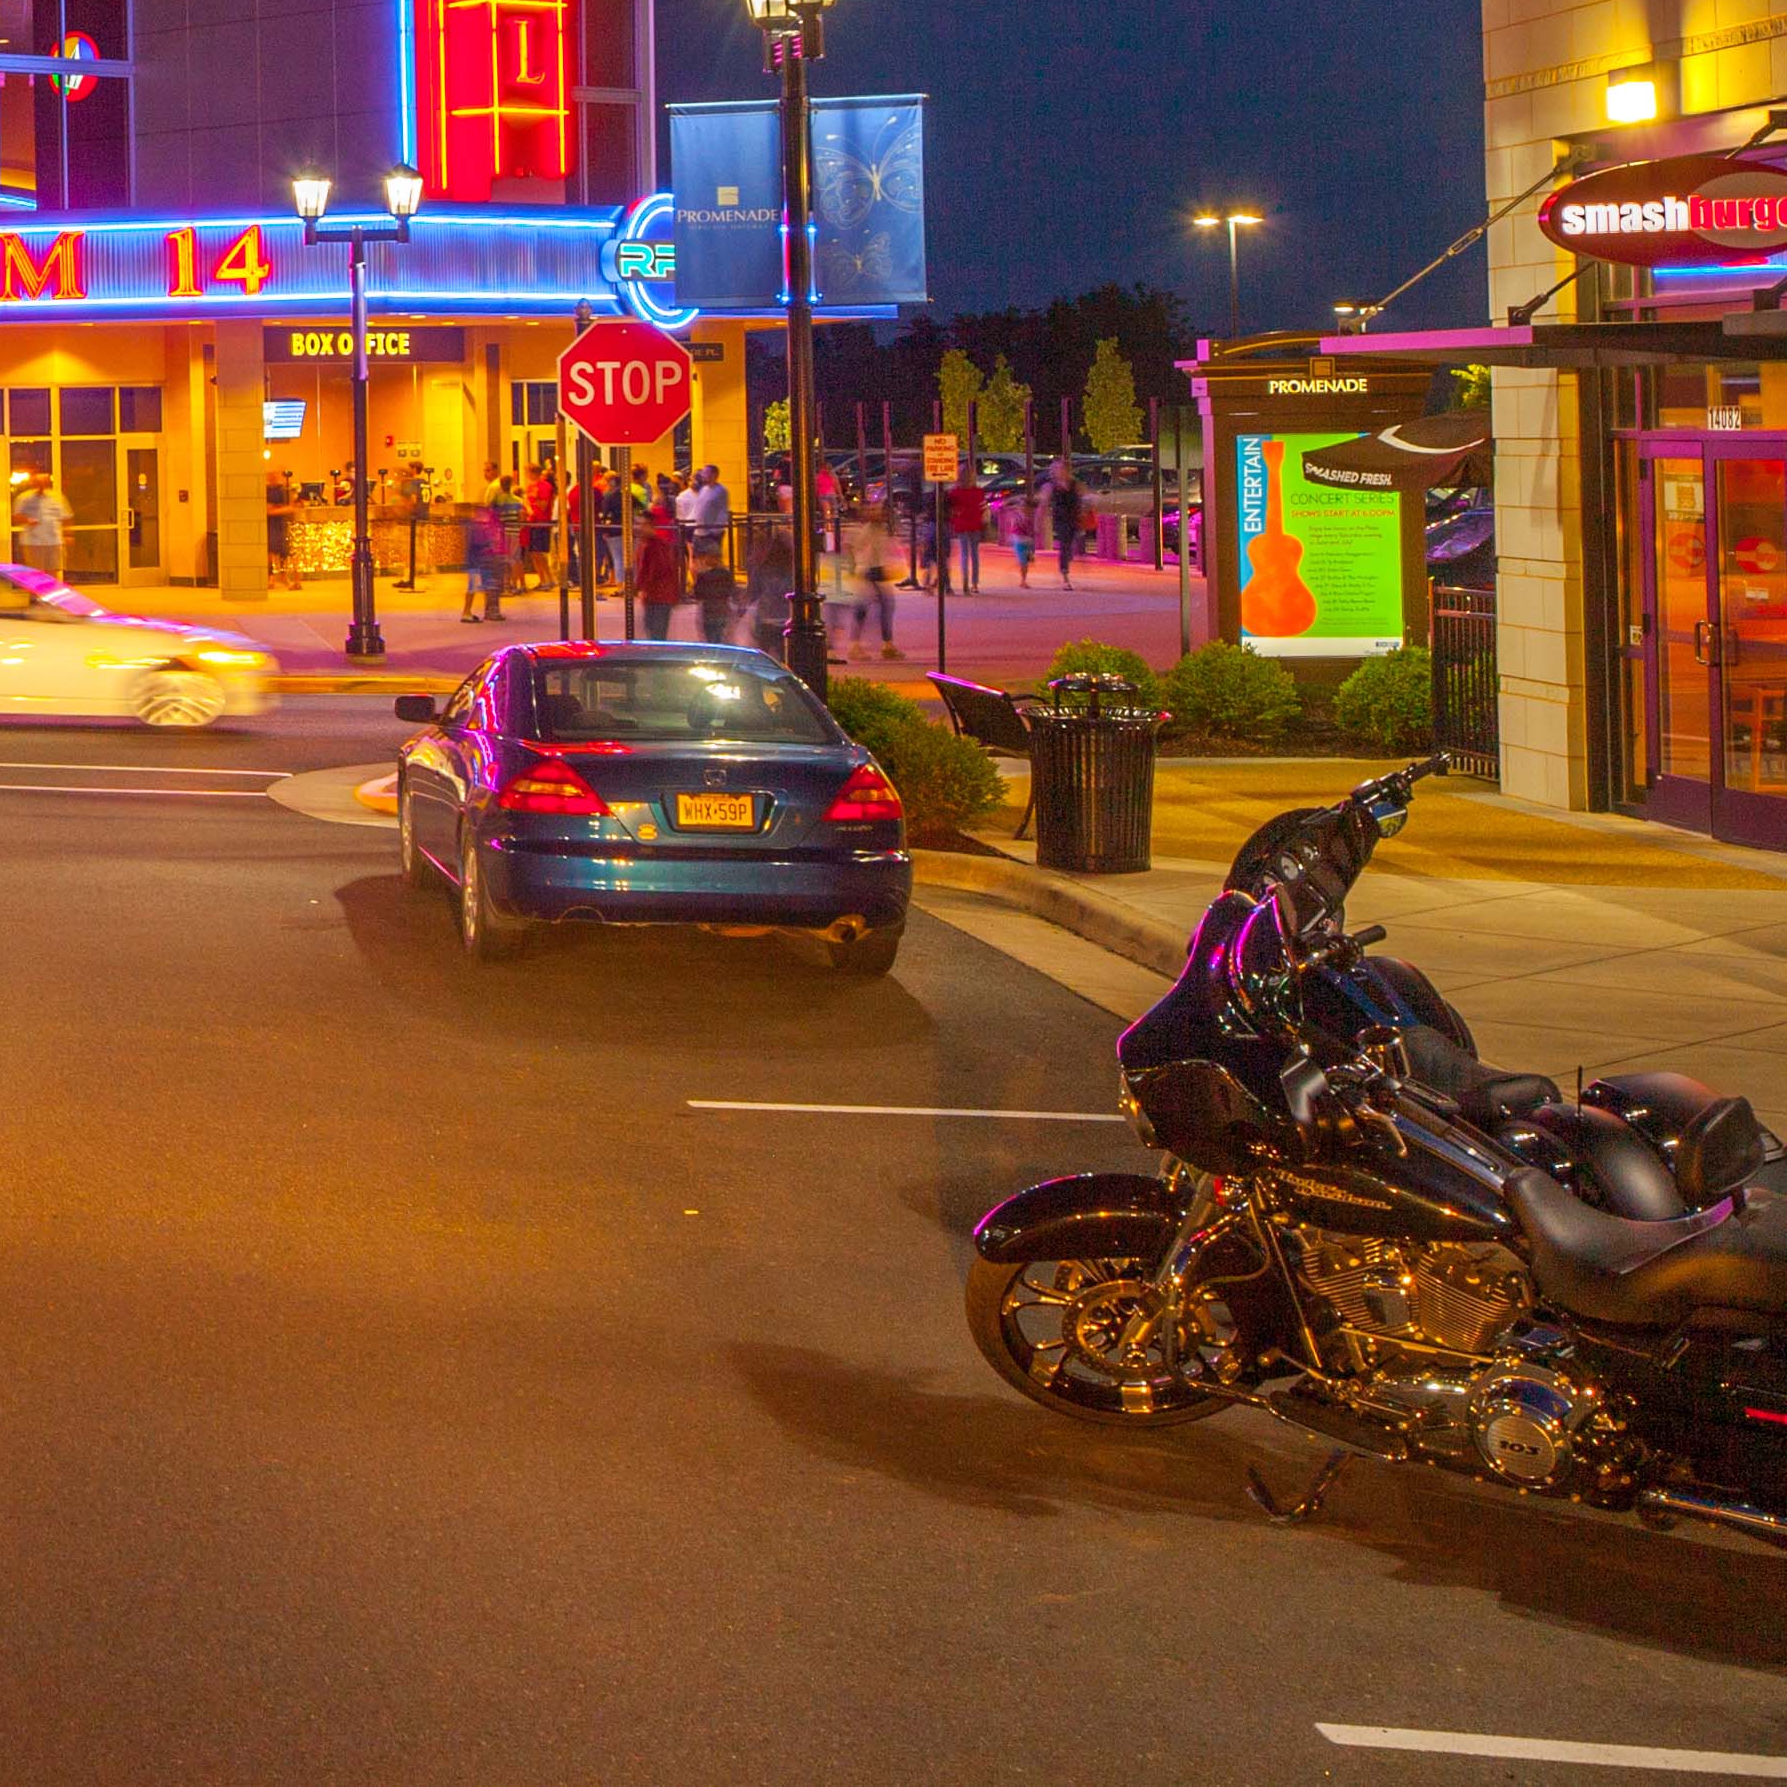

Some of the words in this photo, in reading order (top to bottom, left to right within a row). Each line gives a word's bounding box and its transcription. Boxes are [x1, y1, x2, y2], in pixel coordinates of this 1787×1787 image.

[677, 209, 778, 223] PROMENADE
[167, 224, 272, 298] 14
[291, 332, 334, 356] BOX
[337, 332, 410, 356] OFICE
[568, 360, 683, 407] STOP
[1269, 379, 1368, 394] PROMENADE
[1708, 406, 1741, 430] 14082
[1305, 462, 1359, 483] SMASHED
[1243, 437, 1263, 533] ENTERTAIN
[1290, 493, 1349, 505] CONCERT
[1354, 492, 1395, 504] SERIES
[1290, 510, 1321, 518] SHOWS
